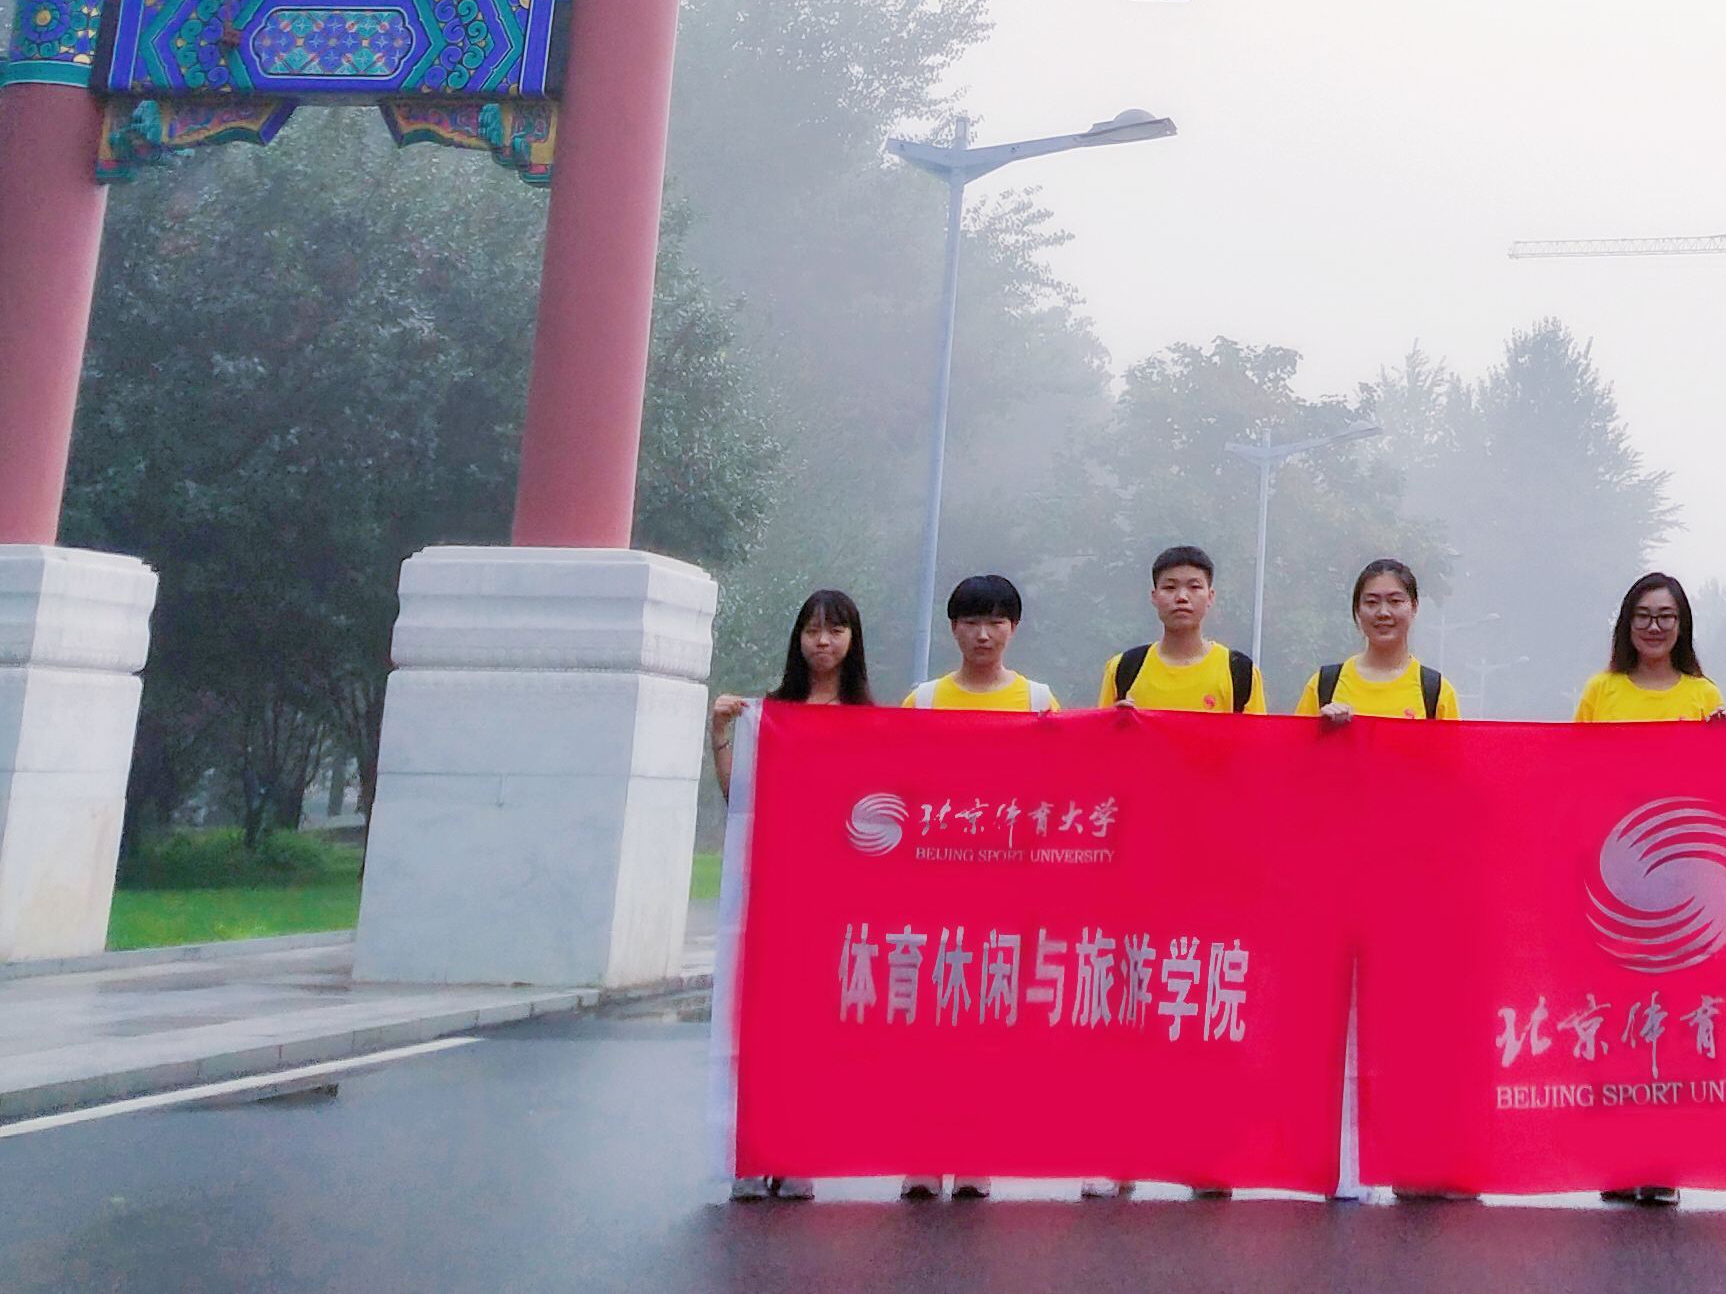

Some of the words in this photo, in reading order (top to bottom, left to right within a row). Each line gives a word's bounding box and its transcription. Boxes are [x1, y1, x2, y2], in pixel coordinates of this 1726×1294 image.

[916, 847, 974, 862] BEIJING
[977, 848, 1025, 862] SPORT
[1030, 849, 1115, 863] UNIVERSITY
[839, 923, 1249, 1042] 体育休闲与旅游学院
[1497, 1085, 1595, 1109] BEIJING
[1603, 1082, 1682, 1106] SPORT
